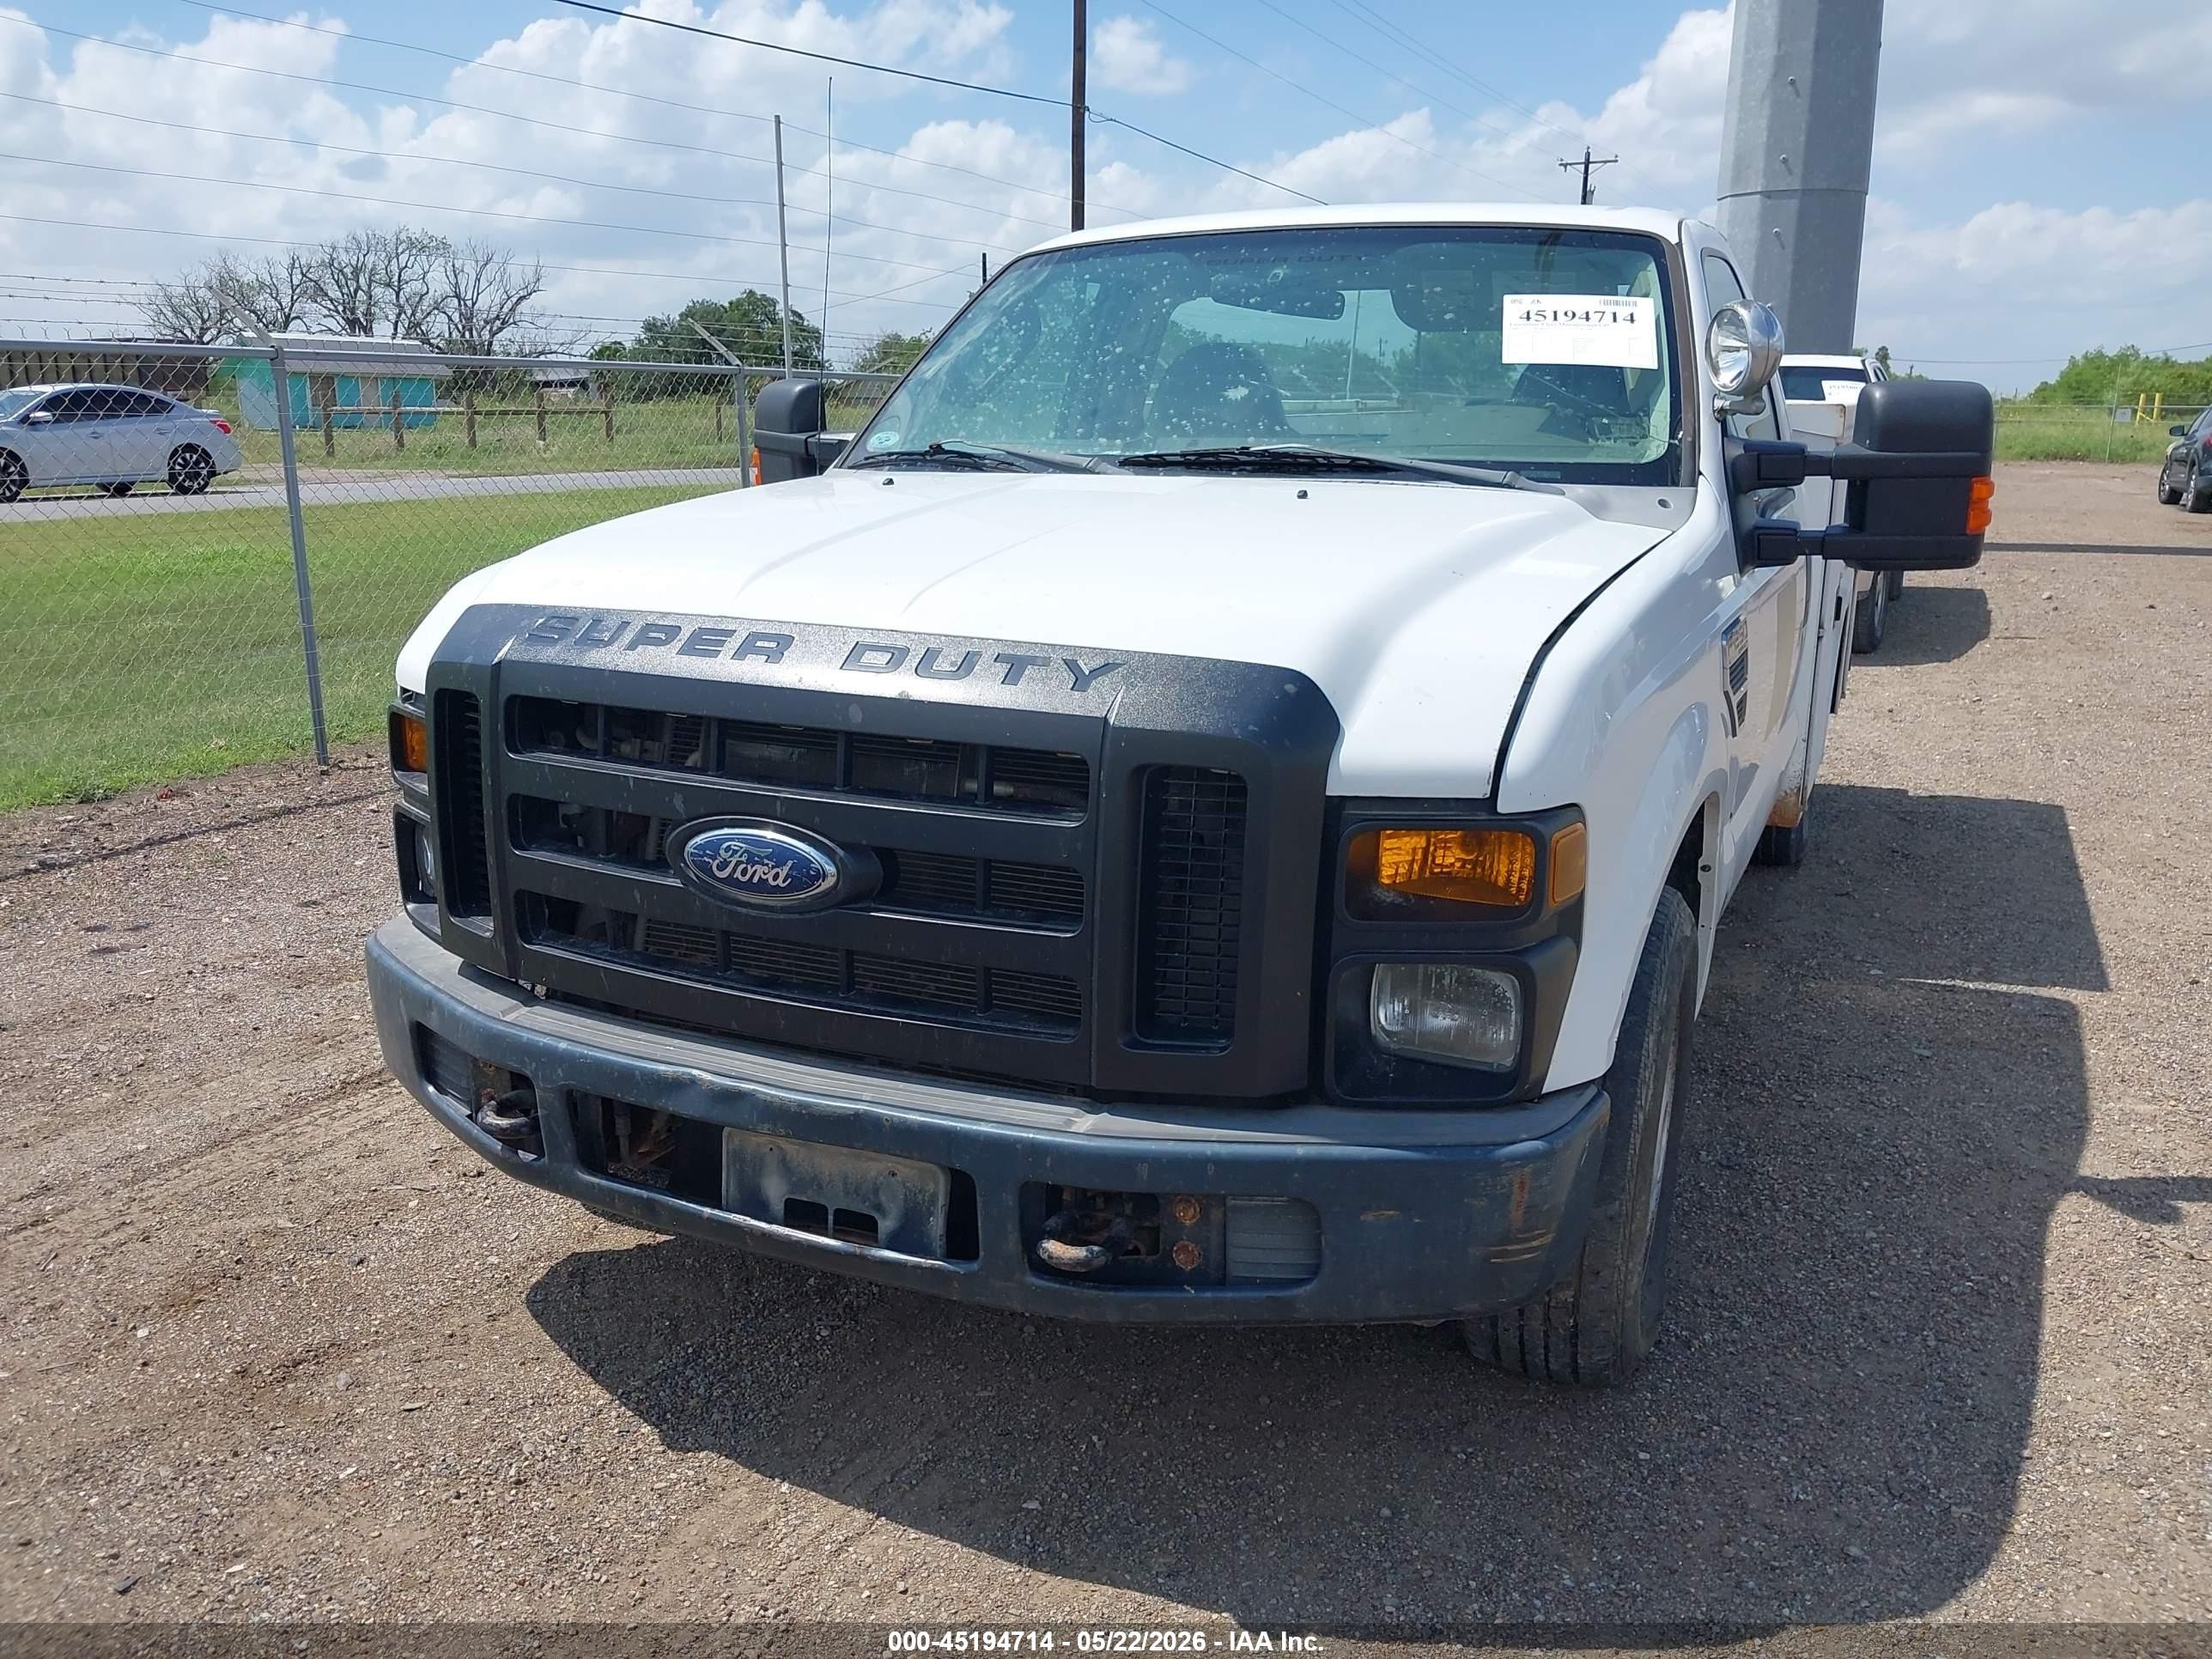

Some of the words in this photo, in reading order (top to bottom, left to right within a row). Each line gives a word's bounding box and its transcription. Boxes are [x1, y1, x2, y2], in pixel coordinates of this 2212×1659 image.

[1519, 310, 1635, 324] 45194714
[523, 615, 795, 665] SUPER
[840, 641, 1127, 692] DUTY
[711, 842, 794, 888] Ford
